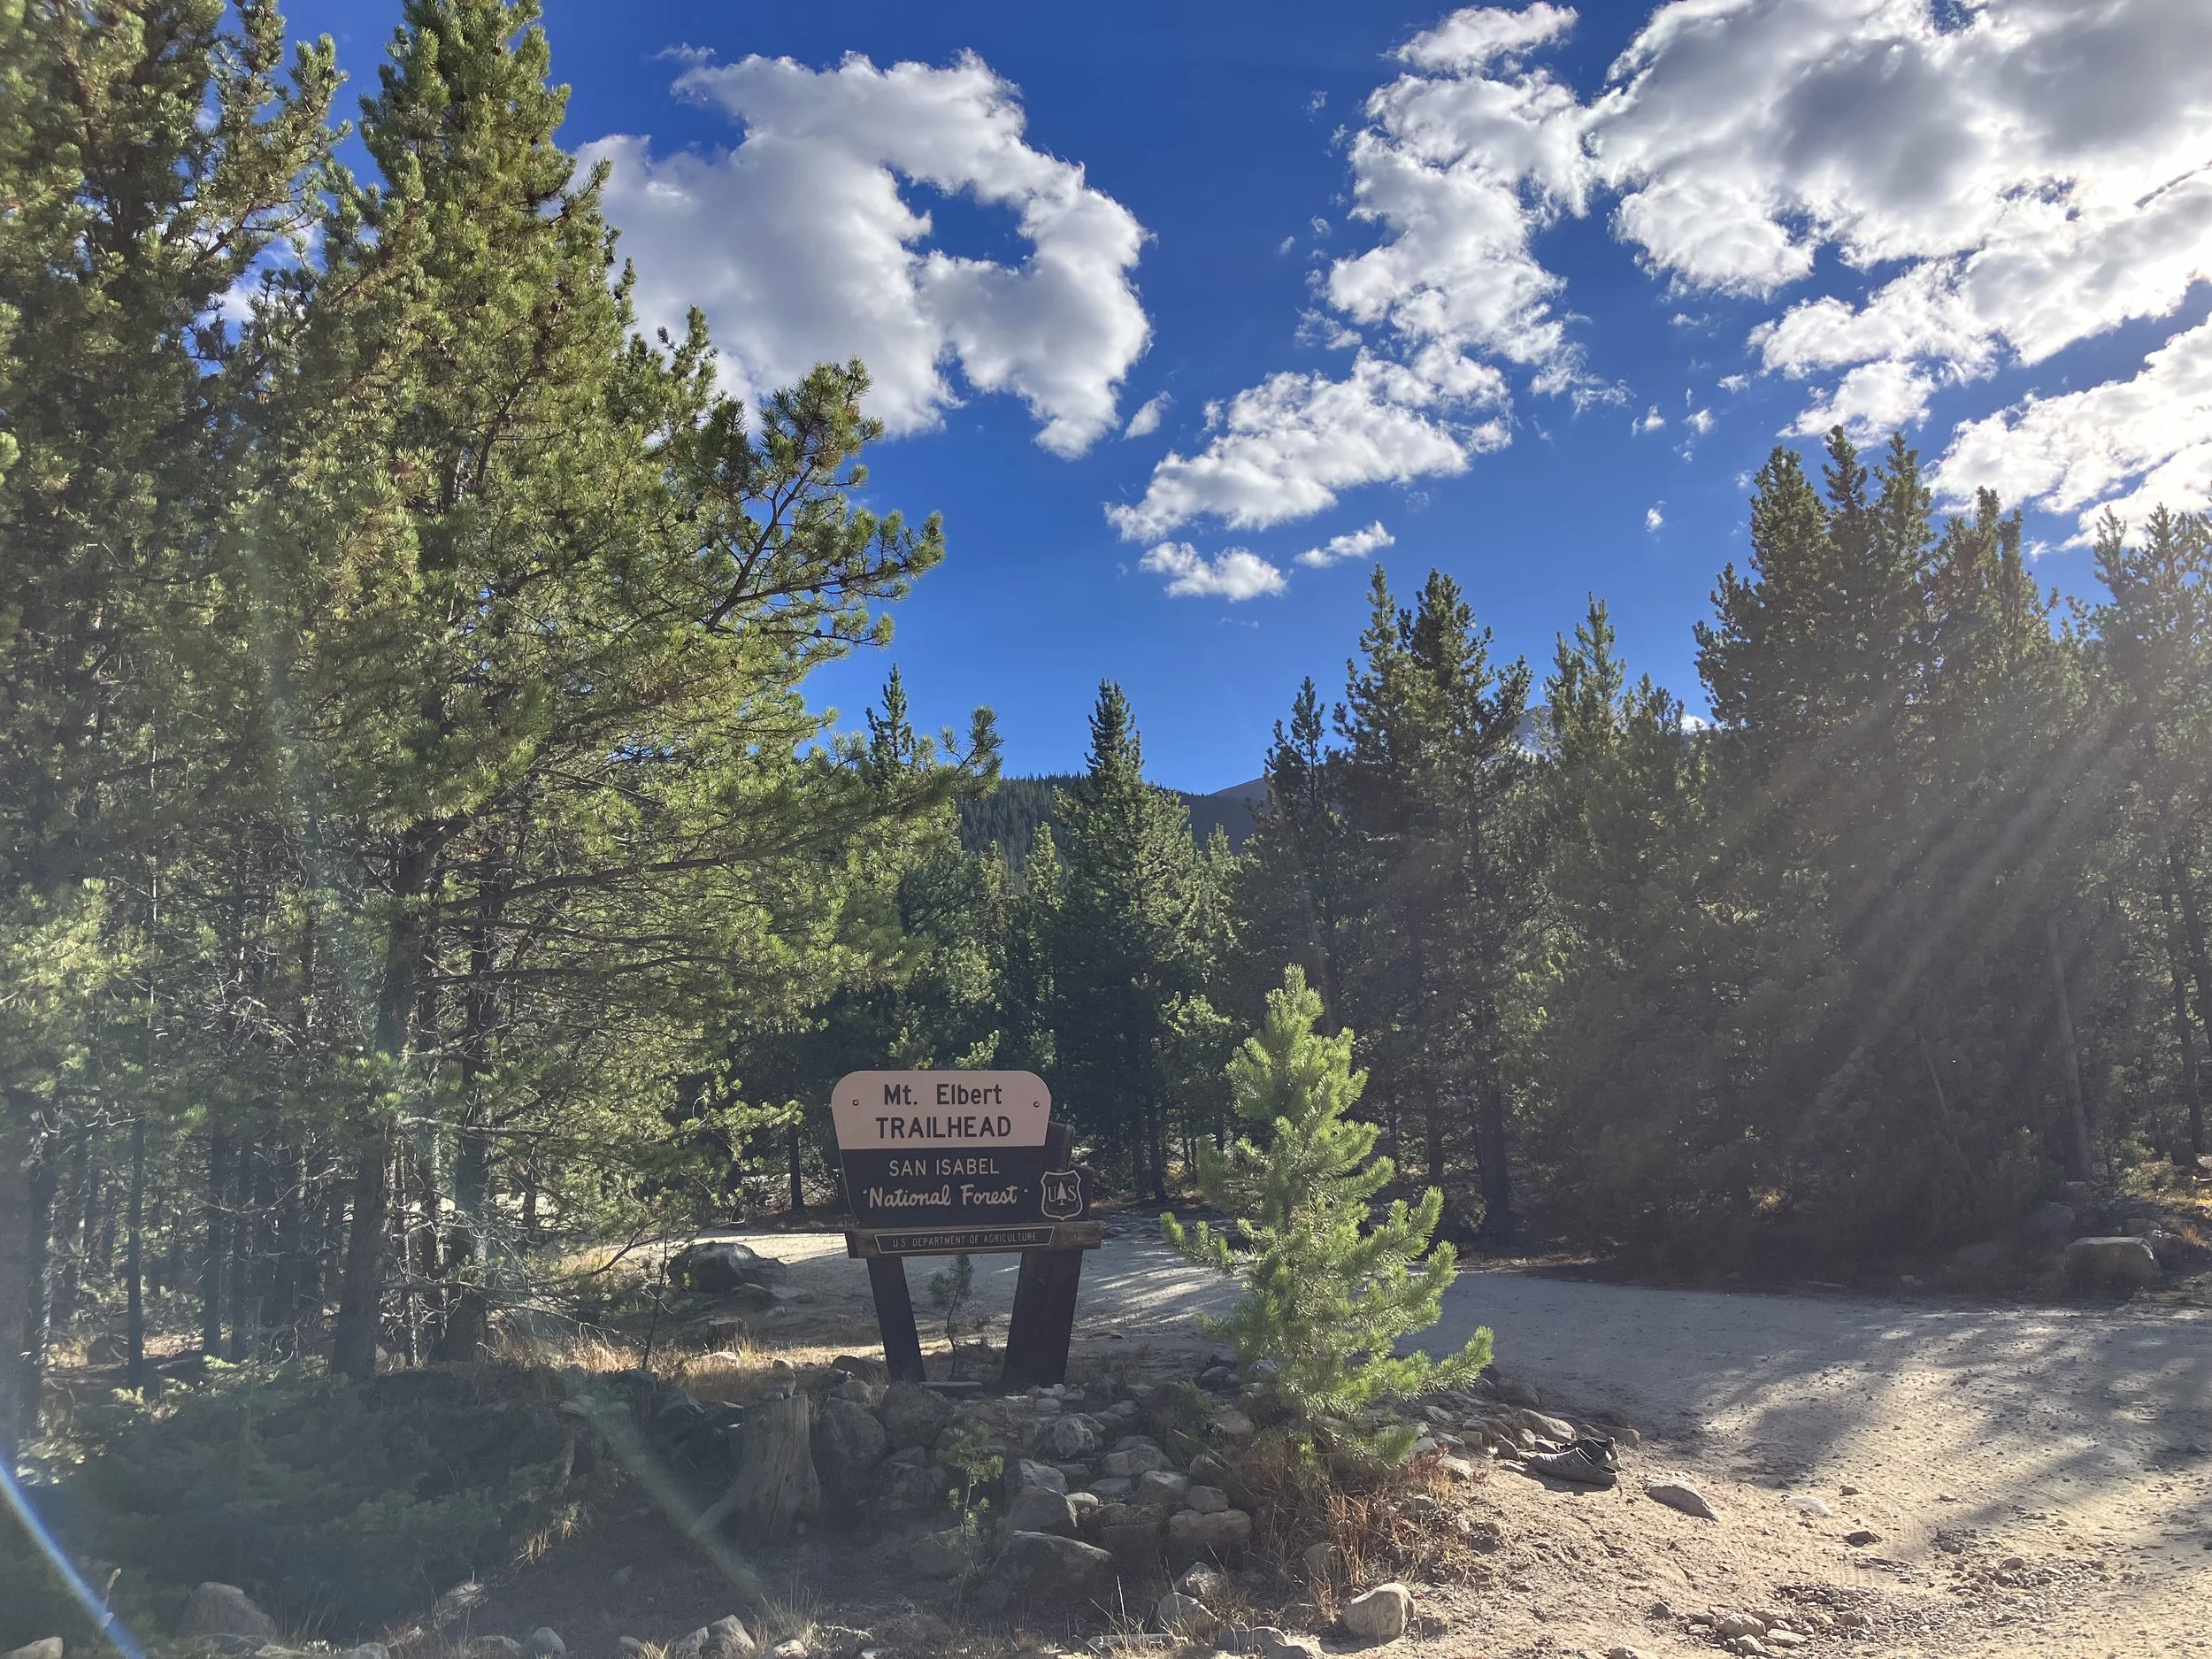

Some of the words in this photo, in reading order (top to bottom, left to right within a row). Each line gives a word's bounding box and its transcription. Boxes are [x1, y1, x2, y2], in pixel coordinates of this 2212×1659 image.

[884, 1083, 918, 1106] Mt.
[936, 1083, 1002, 1105] Elbert
[875, 1116, 1011, 1140] TRAILHEAD
[888, 1159, 926, 1177] SAN
[935, 1158, 1000, 1176] ISABEL
[868, 1184, 951, 1210] National
[959, 1184, 1018, 1206] Forest
[912, 1235, 965, 1248] DEPARTMENT
[969, 1234, 979, 1244] OF
[983, 1231, 1037, 1244] AGRICULTURE
